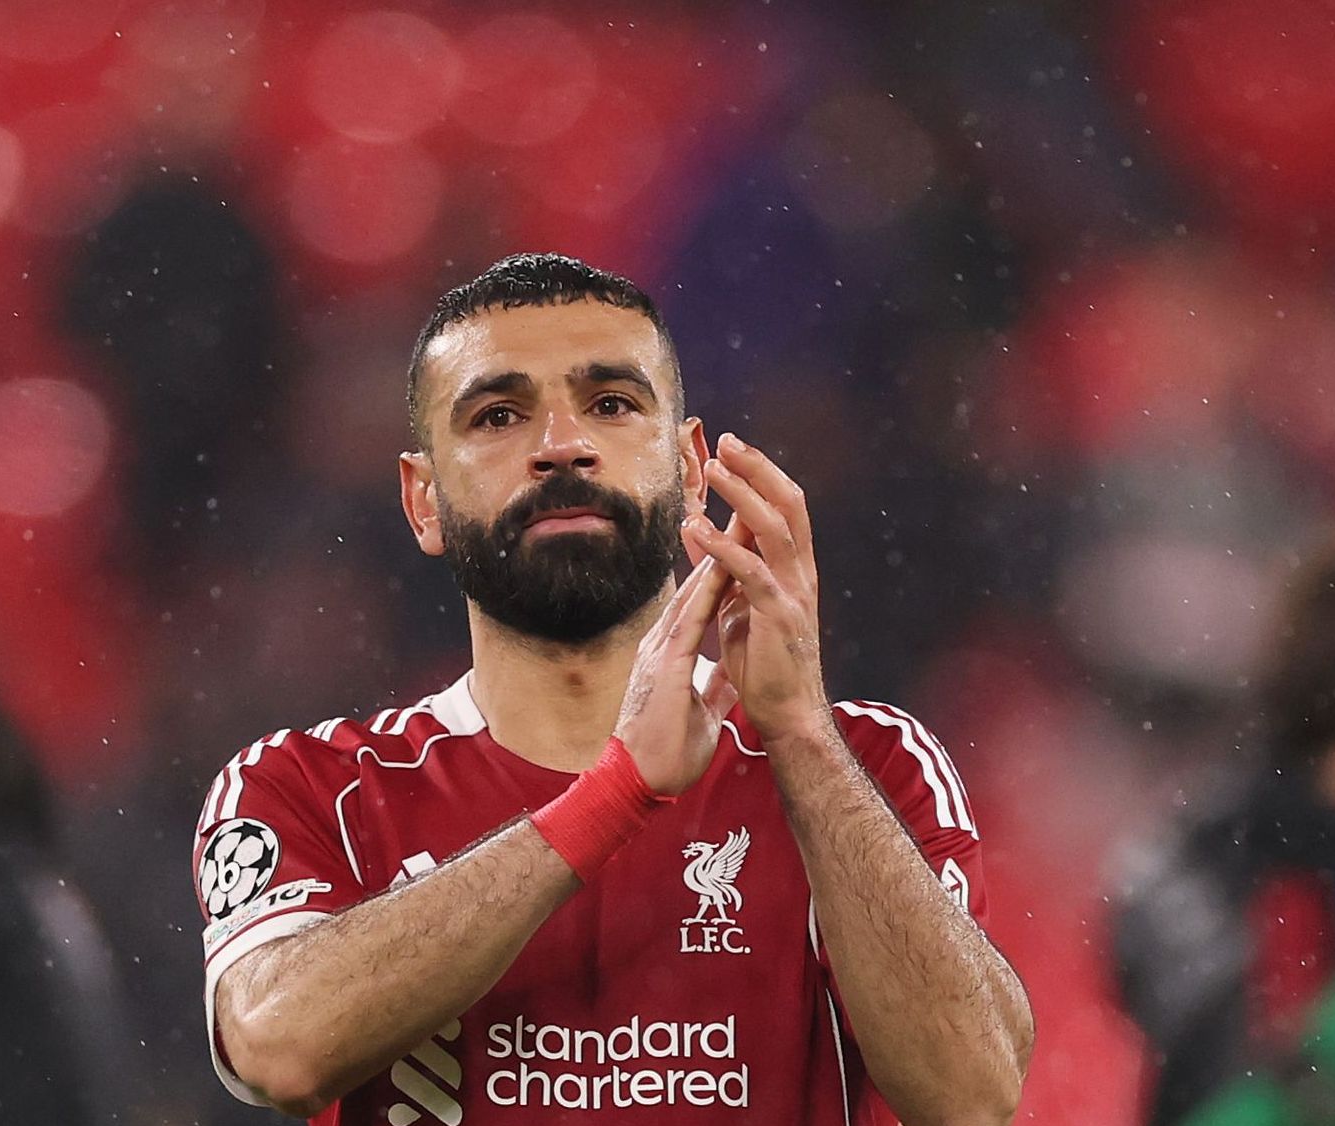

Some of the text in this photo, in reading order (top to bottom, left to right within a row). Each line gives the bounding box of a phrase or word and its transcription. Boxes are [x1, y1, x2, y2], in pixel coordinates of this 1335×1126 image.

[679, 927, 751, 954] L.F.C.
[487, 1014, 735, 1064] standard
[486, 1061, 748, 1110] chartered
